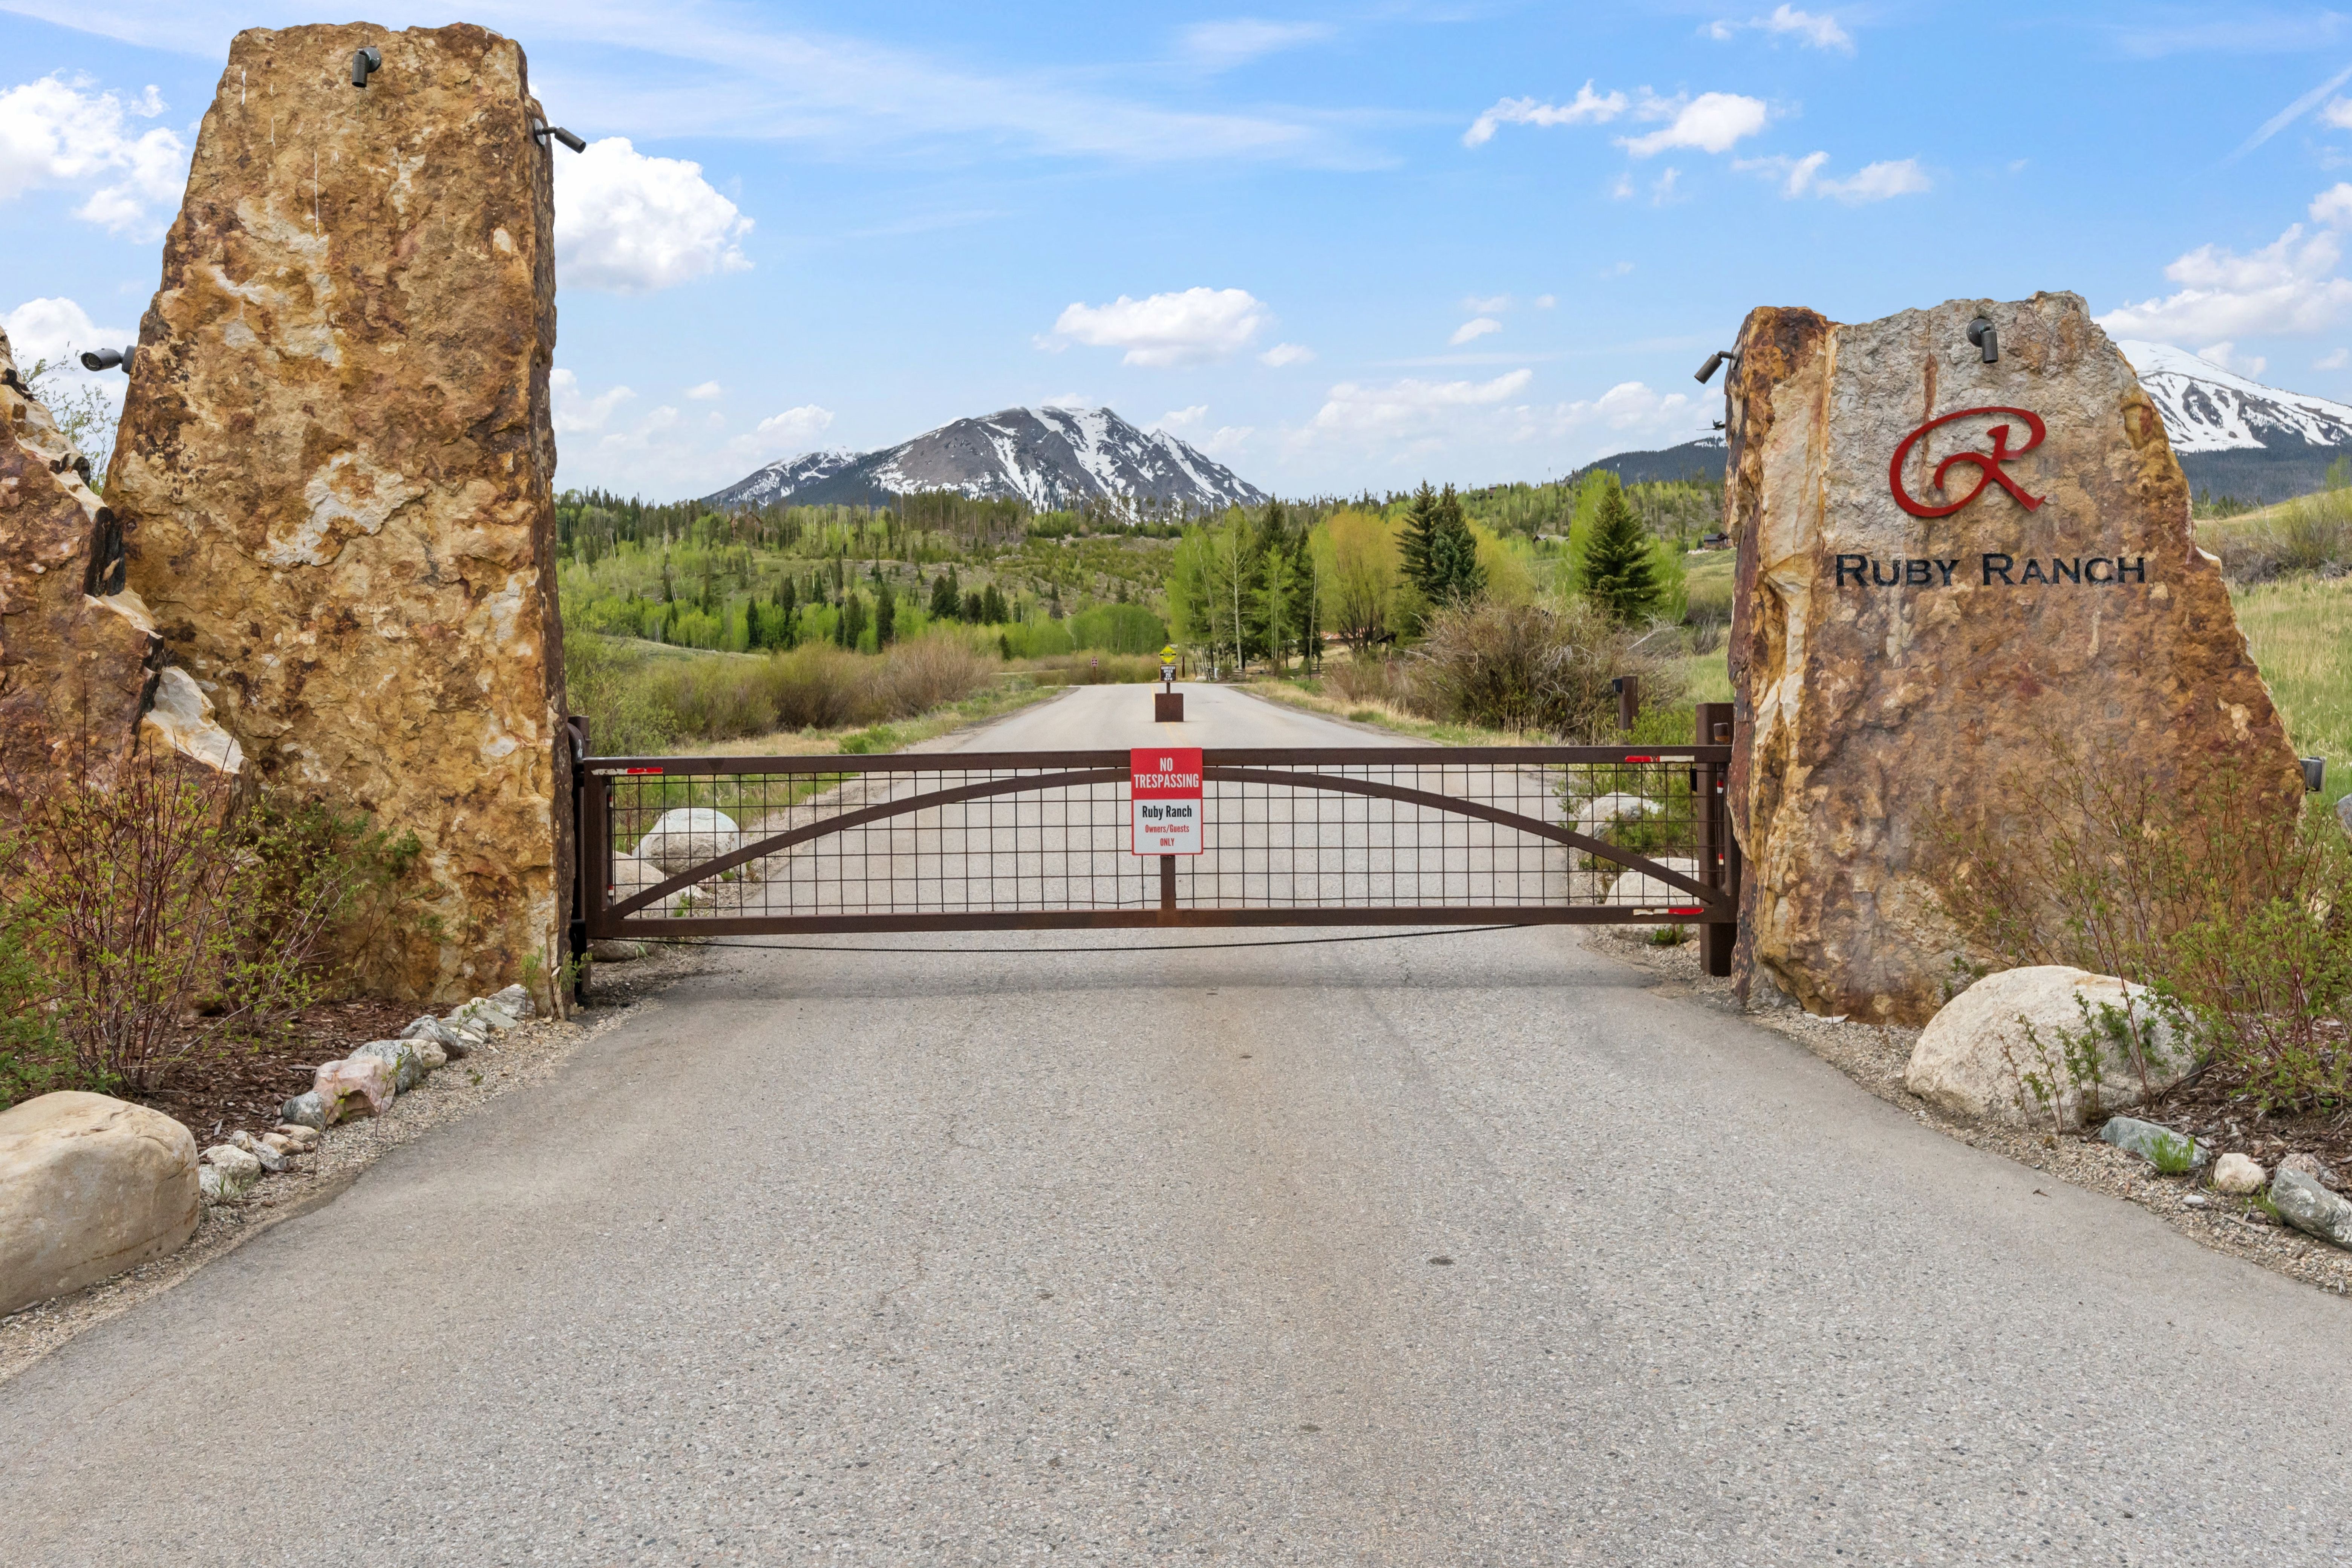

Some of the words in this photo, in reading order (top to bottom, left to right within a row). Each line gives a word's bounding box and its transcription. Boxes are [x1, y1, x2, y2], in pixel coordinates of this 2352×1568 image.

[1836, 554, 1960, 587] RUBY
[1981, 553, 2146, 586] RANCH
[1160, 757, 1173, 772] NO
[1133, 773, 1199, 788] TRESPASSING
[1142, 805, 1164, 821] Ruby
[1166, 805, 1192, 818] Ranch
[1145, 824, 1190, 833] Owners/Guests
[1160, 838, 1175, 847] ONLY
